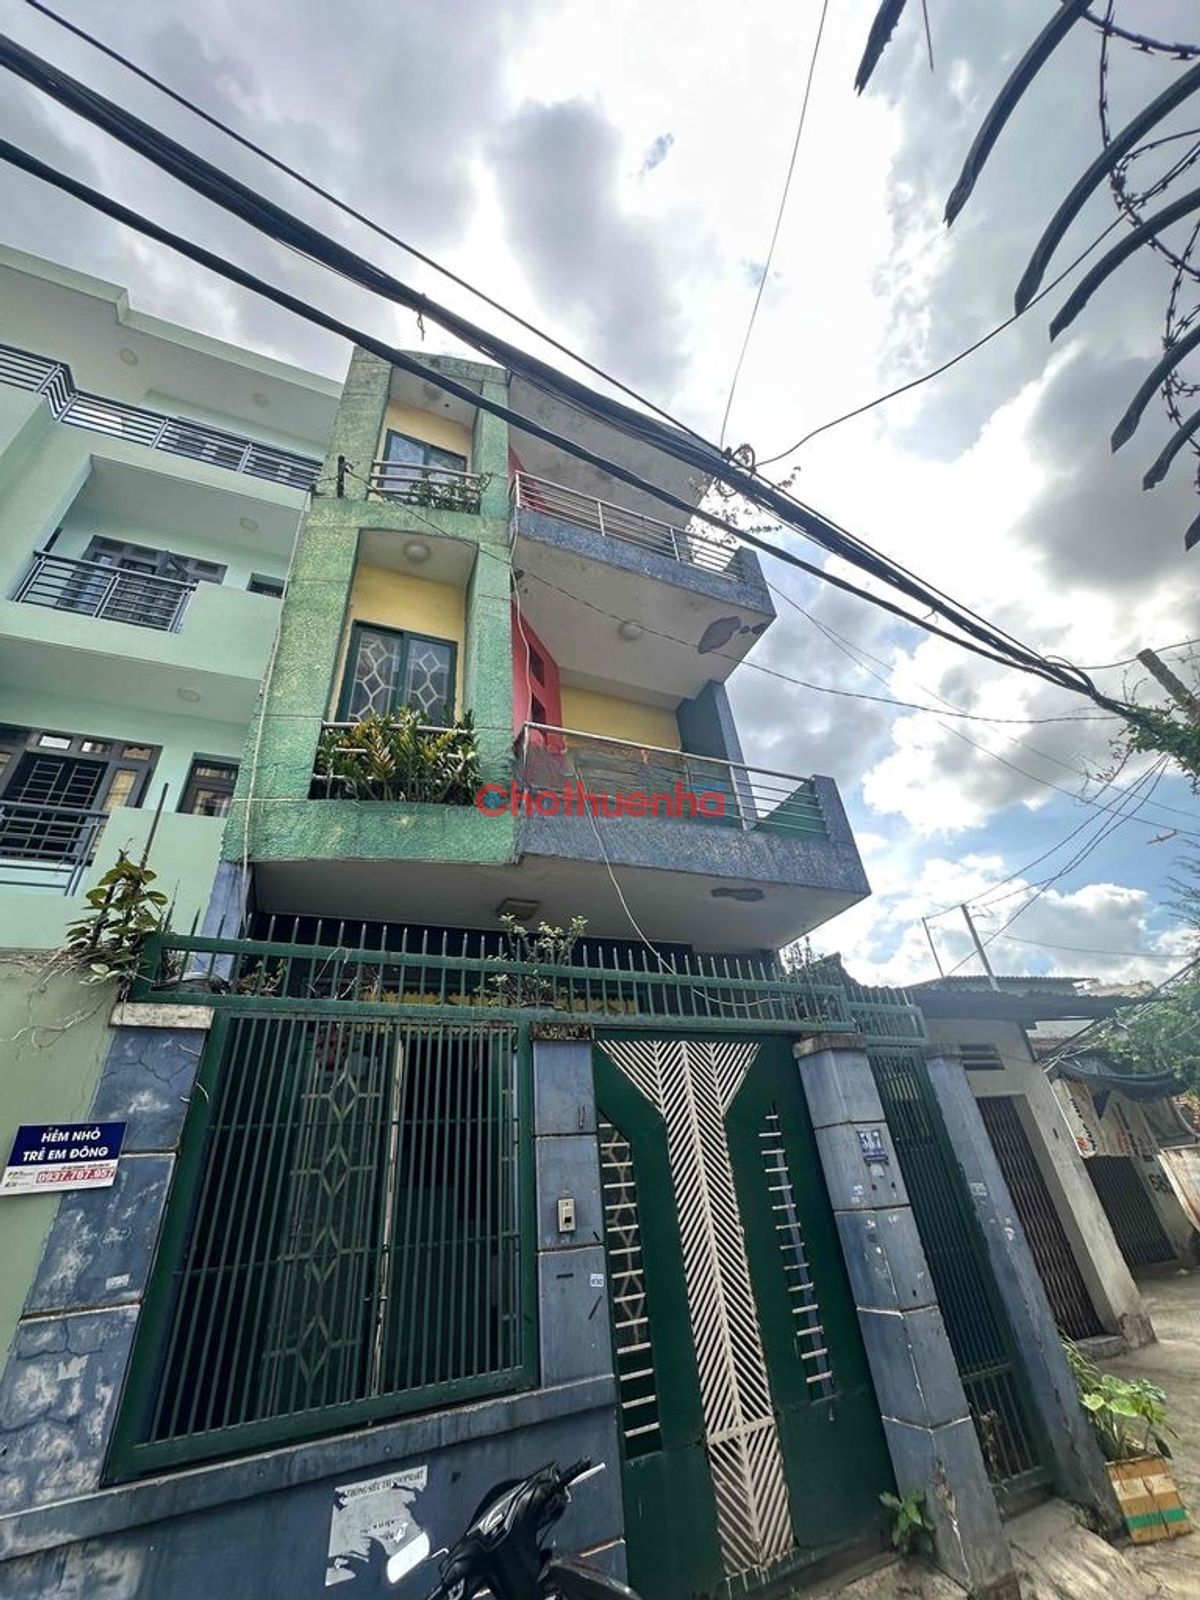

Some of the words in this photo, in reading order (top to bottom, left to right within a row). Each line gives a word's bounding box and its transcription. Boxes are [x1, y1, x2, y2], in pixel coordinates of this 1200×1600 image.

[41, 1128, 69, 1143] HẺM
[72, 1127, 101, 1140] NHỎ
[23, 1147, 46, 1162] TRẺ
[47, 1149, 67, 1160] EM
